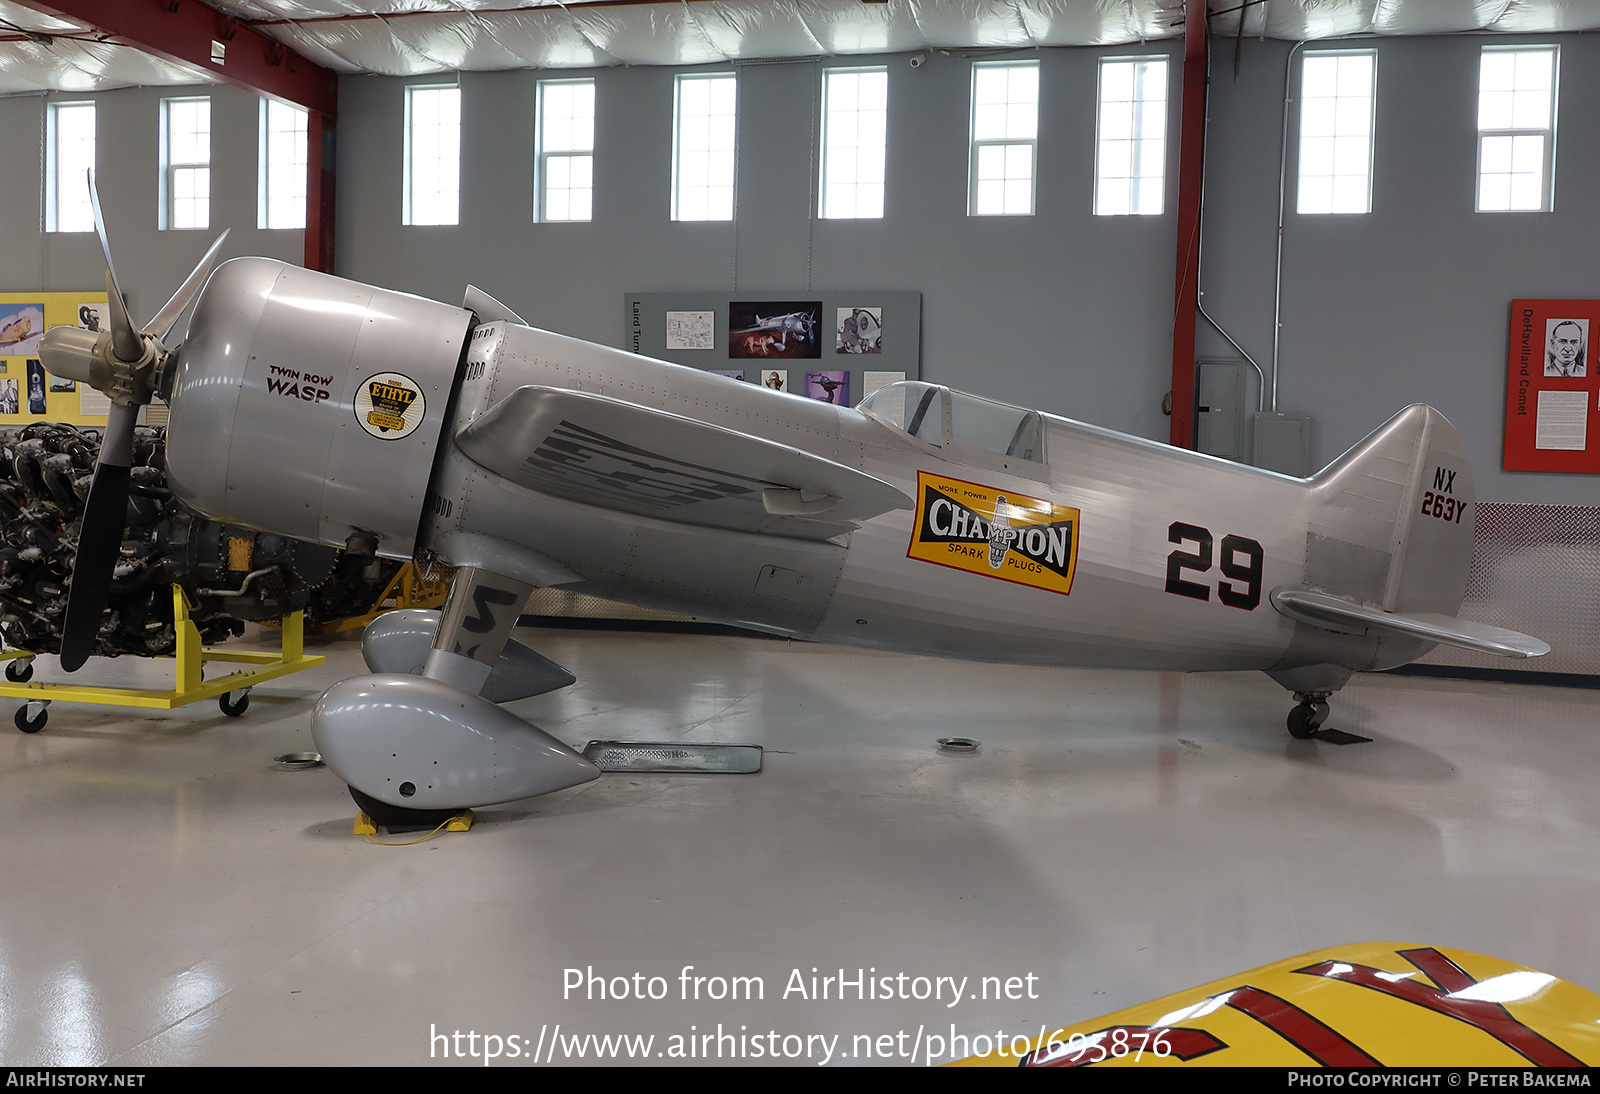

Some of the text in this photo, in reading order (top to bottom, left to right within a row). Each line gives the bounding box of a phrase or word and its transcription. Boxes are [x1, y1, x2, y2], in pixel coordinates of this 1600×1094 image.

[633, 302, 641, 326] Laird
[270, 364, 334, 386] TWIN ROW
[1518, 309, 1534, 416] DeHavilland Comet
[266, 377, 330, 404] WASP
[371, 383, 413, 404] ETHYL
[938, 484, 959, 495] MORE
[963, 490, 988, 501] POWER
[1433, 466, 1457, 494] NX
[1421, 490, 1468, 524] 263Y
[928, 498, 1068, 568] CHAMPION
[947, 543, 1043, 574] SPARK PLUGS
[1165, 521, 1264, 611] 29
